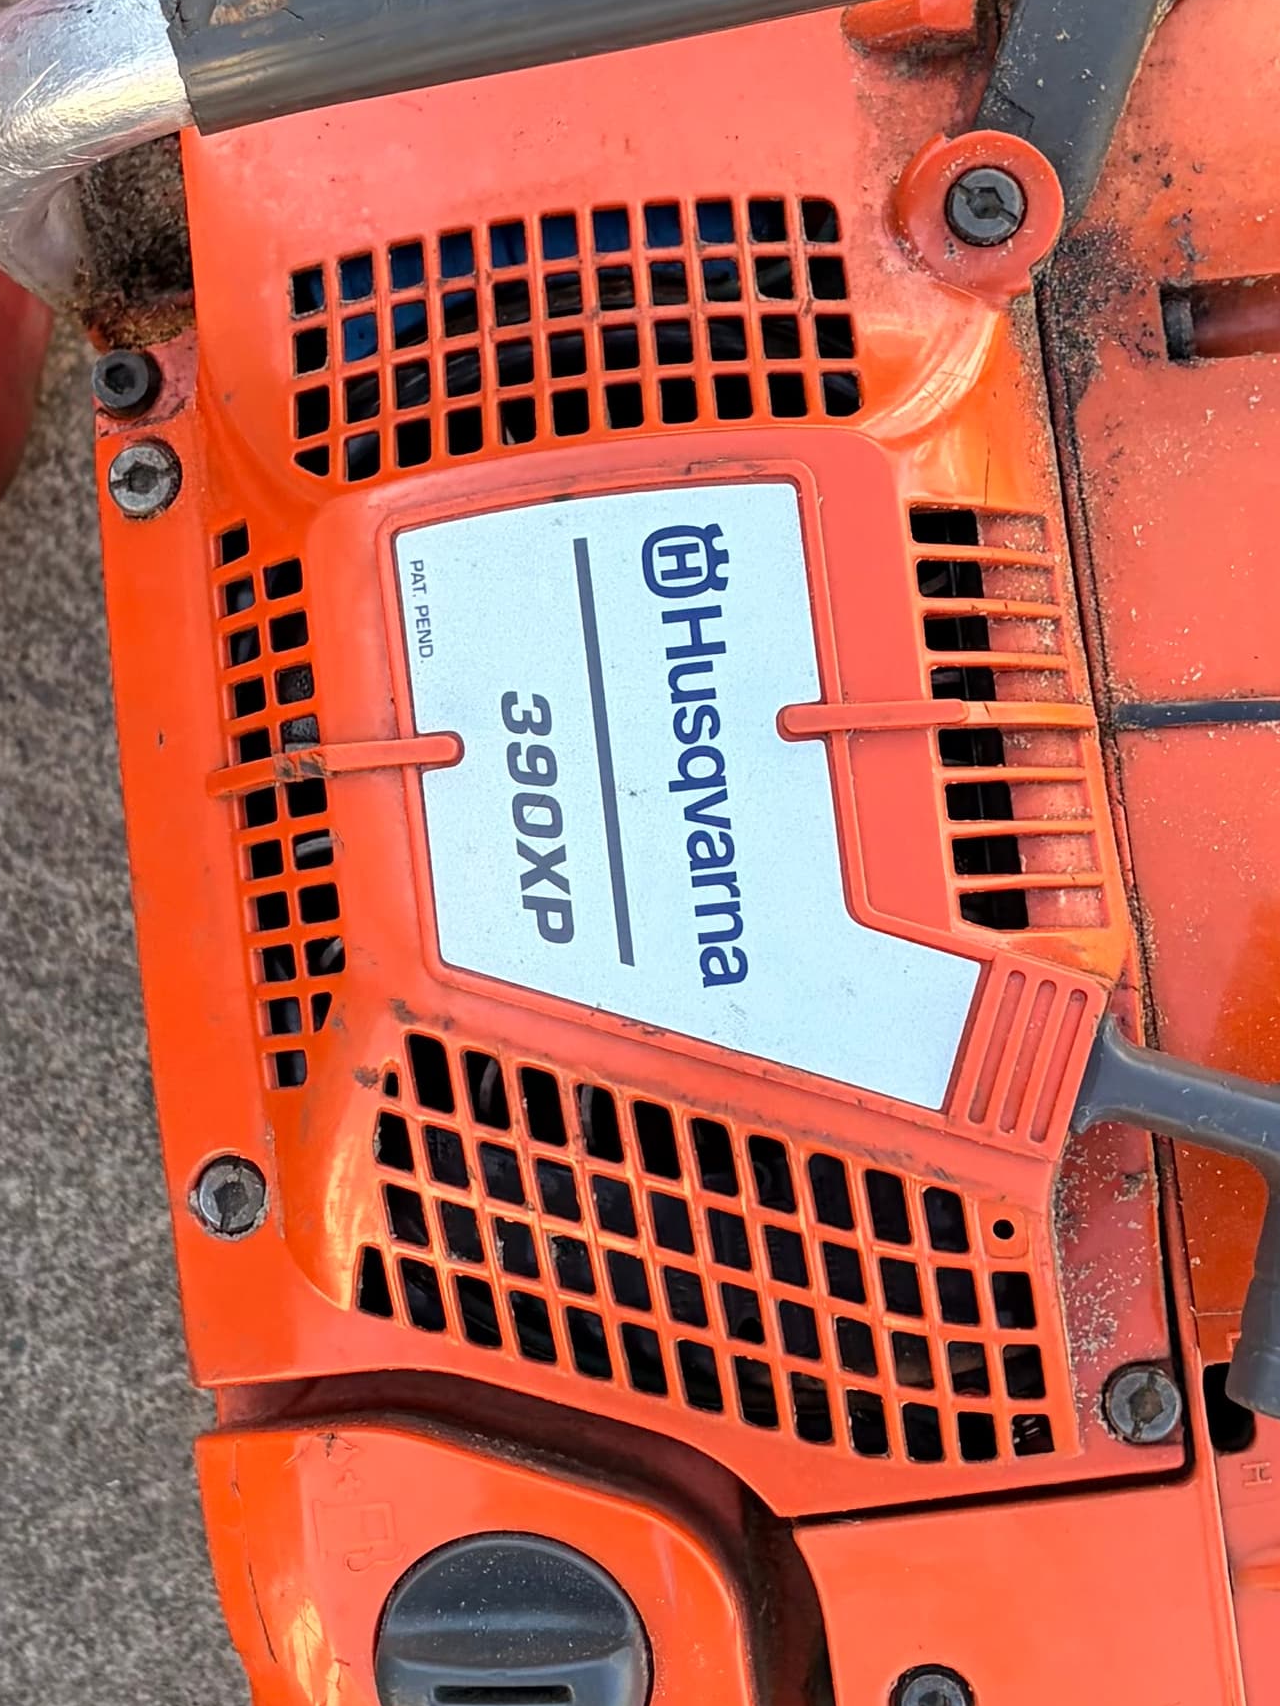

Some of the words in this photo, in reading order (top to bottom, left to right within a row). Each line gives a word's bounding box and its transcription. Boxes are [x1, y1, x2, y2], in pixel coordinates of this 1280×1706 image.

[410, 559, 426, 597] PAT.
[414, 605, 434, 663] PEND.
[501, 691, 575, 944] 390XP
[661, 605, 749, 988] Husqvarna
